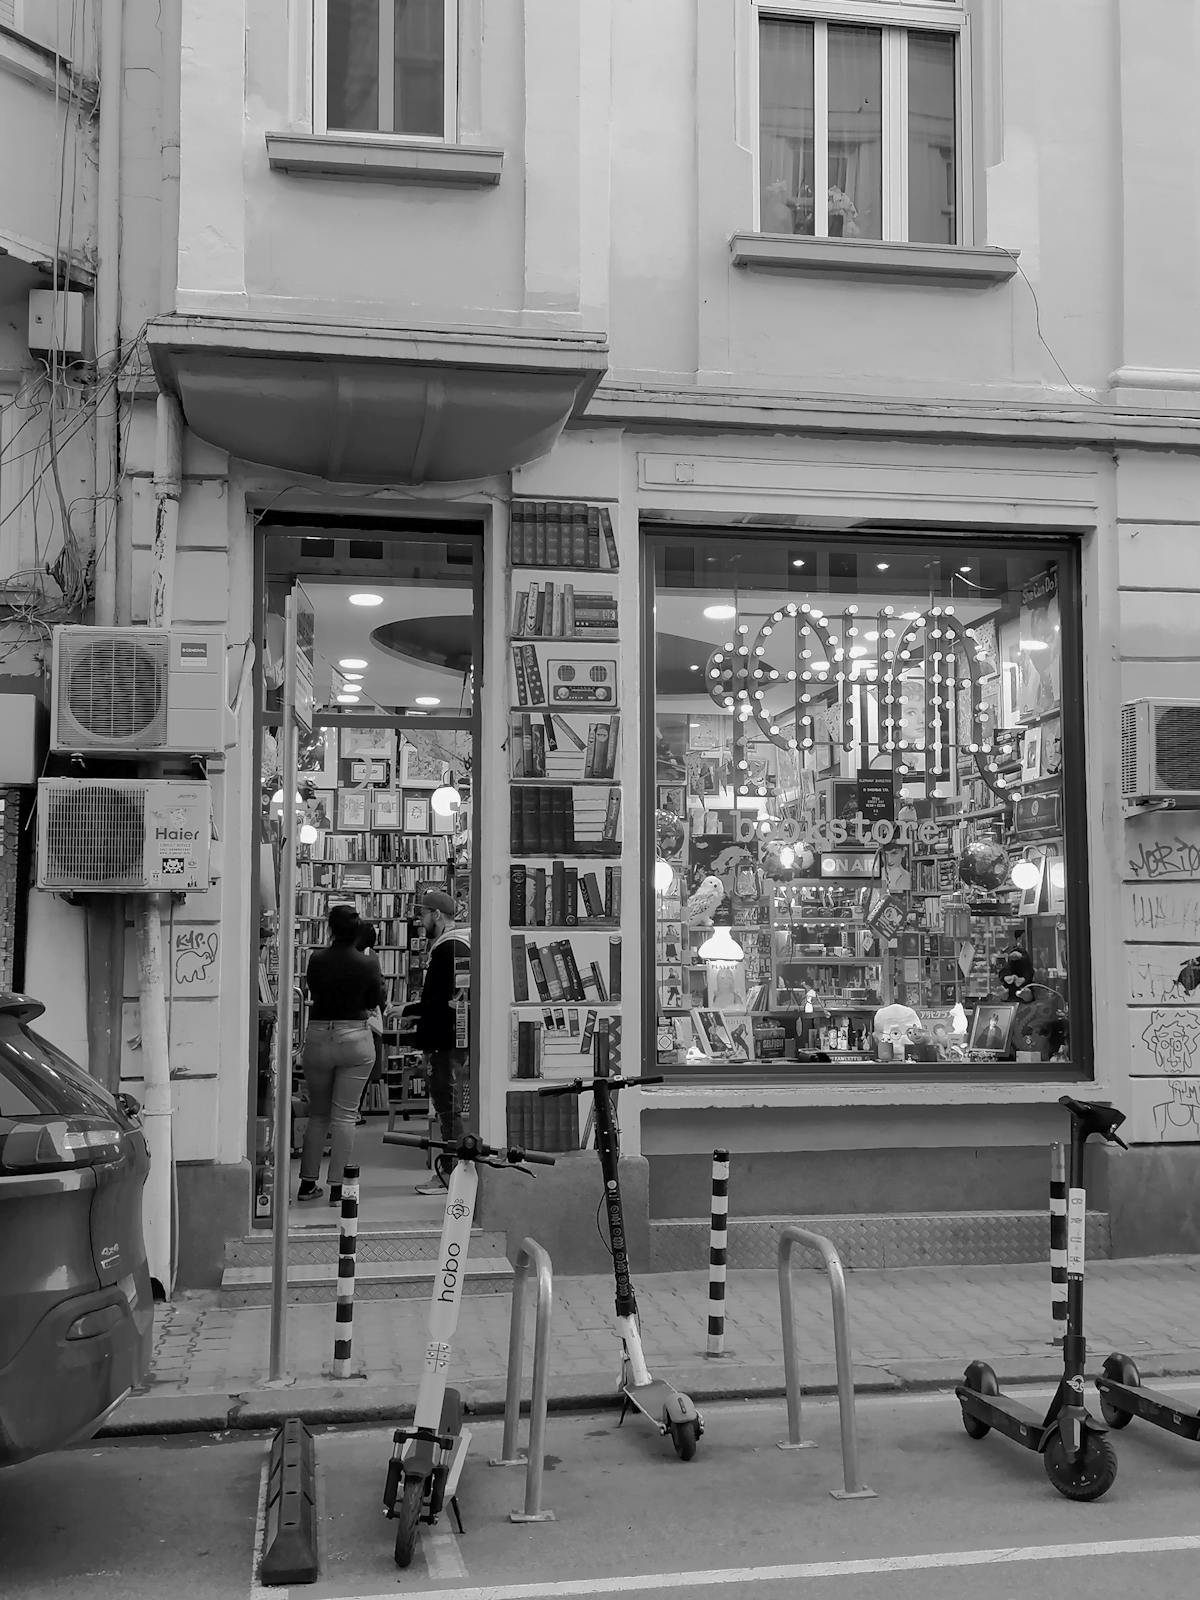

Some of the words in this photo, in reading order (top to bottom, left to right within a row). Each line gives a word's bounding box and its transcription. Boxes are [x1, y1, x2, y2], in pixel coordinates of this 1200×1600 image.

[155, 827, 200, 841] Haier
[729, 810, 940, 846] bookstore
[822, 858, 849, 872] ON
[850, 858, 880, 872] AIR
